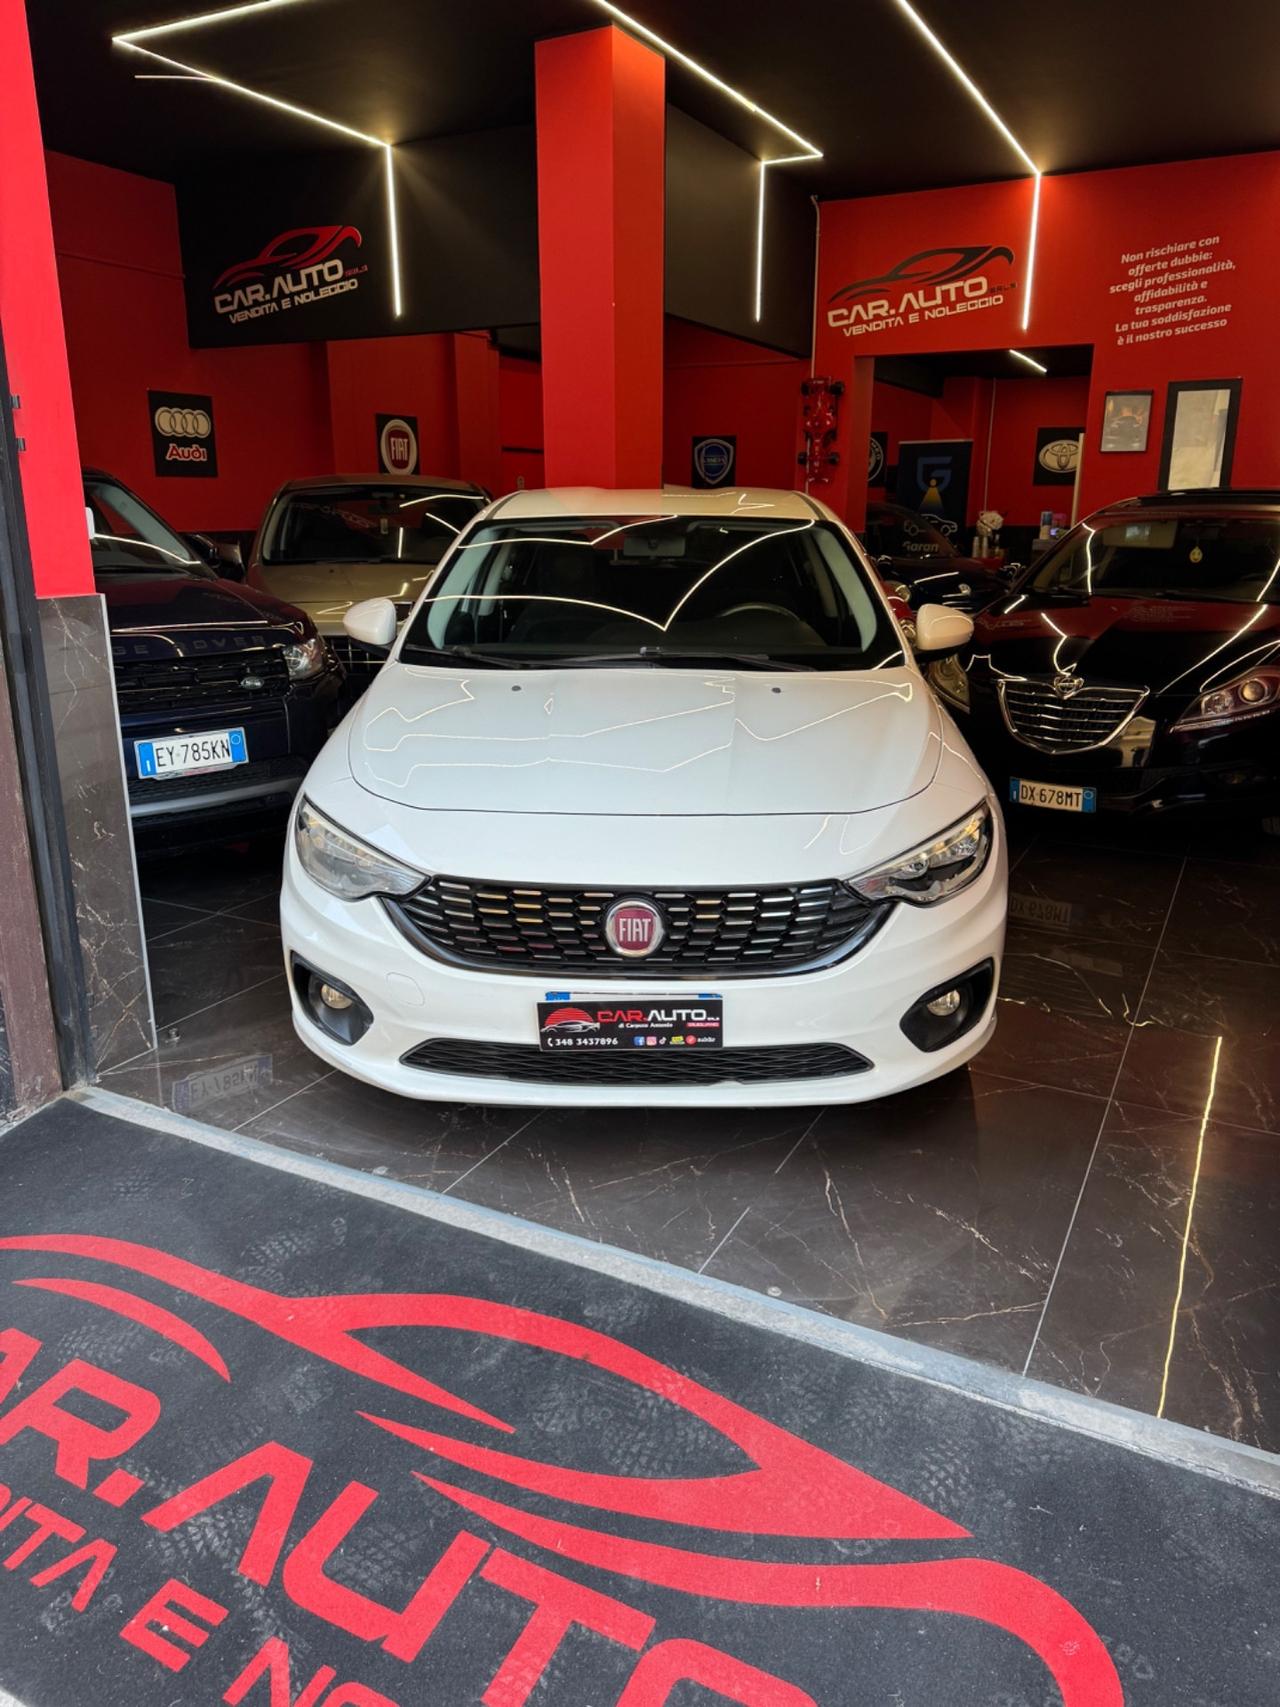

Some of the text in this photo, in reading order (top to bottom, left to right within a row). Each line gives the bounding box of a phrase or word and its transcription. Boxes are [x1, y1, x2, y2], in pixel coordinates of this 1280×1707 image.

[1121, 235, 1220, 264] Non rischiare con
[1109, 259, 1236, 294] scegli professionalità,
[1128, 251, 1213, 277] offerte dubbie:
[214, 258, 344, 314] CAR.AUTO
[1134, 280, 1208, 304] affidabilità e
[229, 278, 359, 324] VENDITA E NOLEGGIO
[827, 276, 988, 328] CAR.AUTO
[1135, 295, 1208, 315] trasparenza.
[842, 294, 1004, 337] VENDITA E NOLEGGIO
[1115, 303, 1232, 333] La tua soddisfazione
[1117, 318, 1228, 346] è il nostro successo
[166, 443, 208, 462] Audi
[390, 436, 409, 461] FIAT
[155, 739, 231, 768] EY 785KN
[1020, 785, 1082, 808] DX 678MT
[619, 918, 651, 942] FIAT
[597, 1009, 707, 1023] CAR.AUTO
[555, 1037, 618, 1046] 348 3437896
[119, 1578, 230, 1673] E
